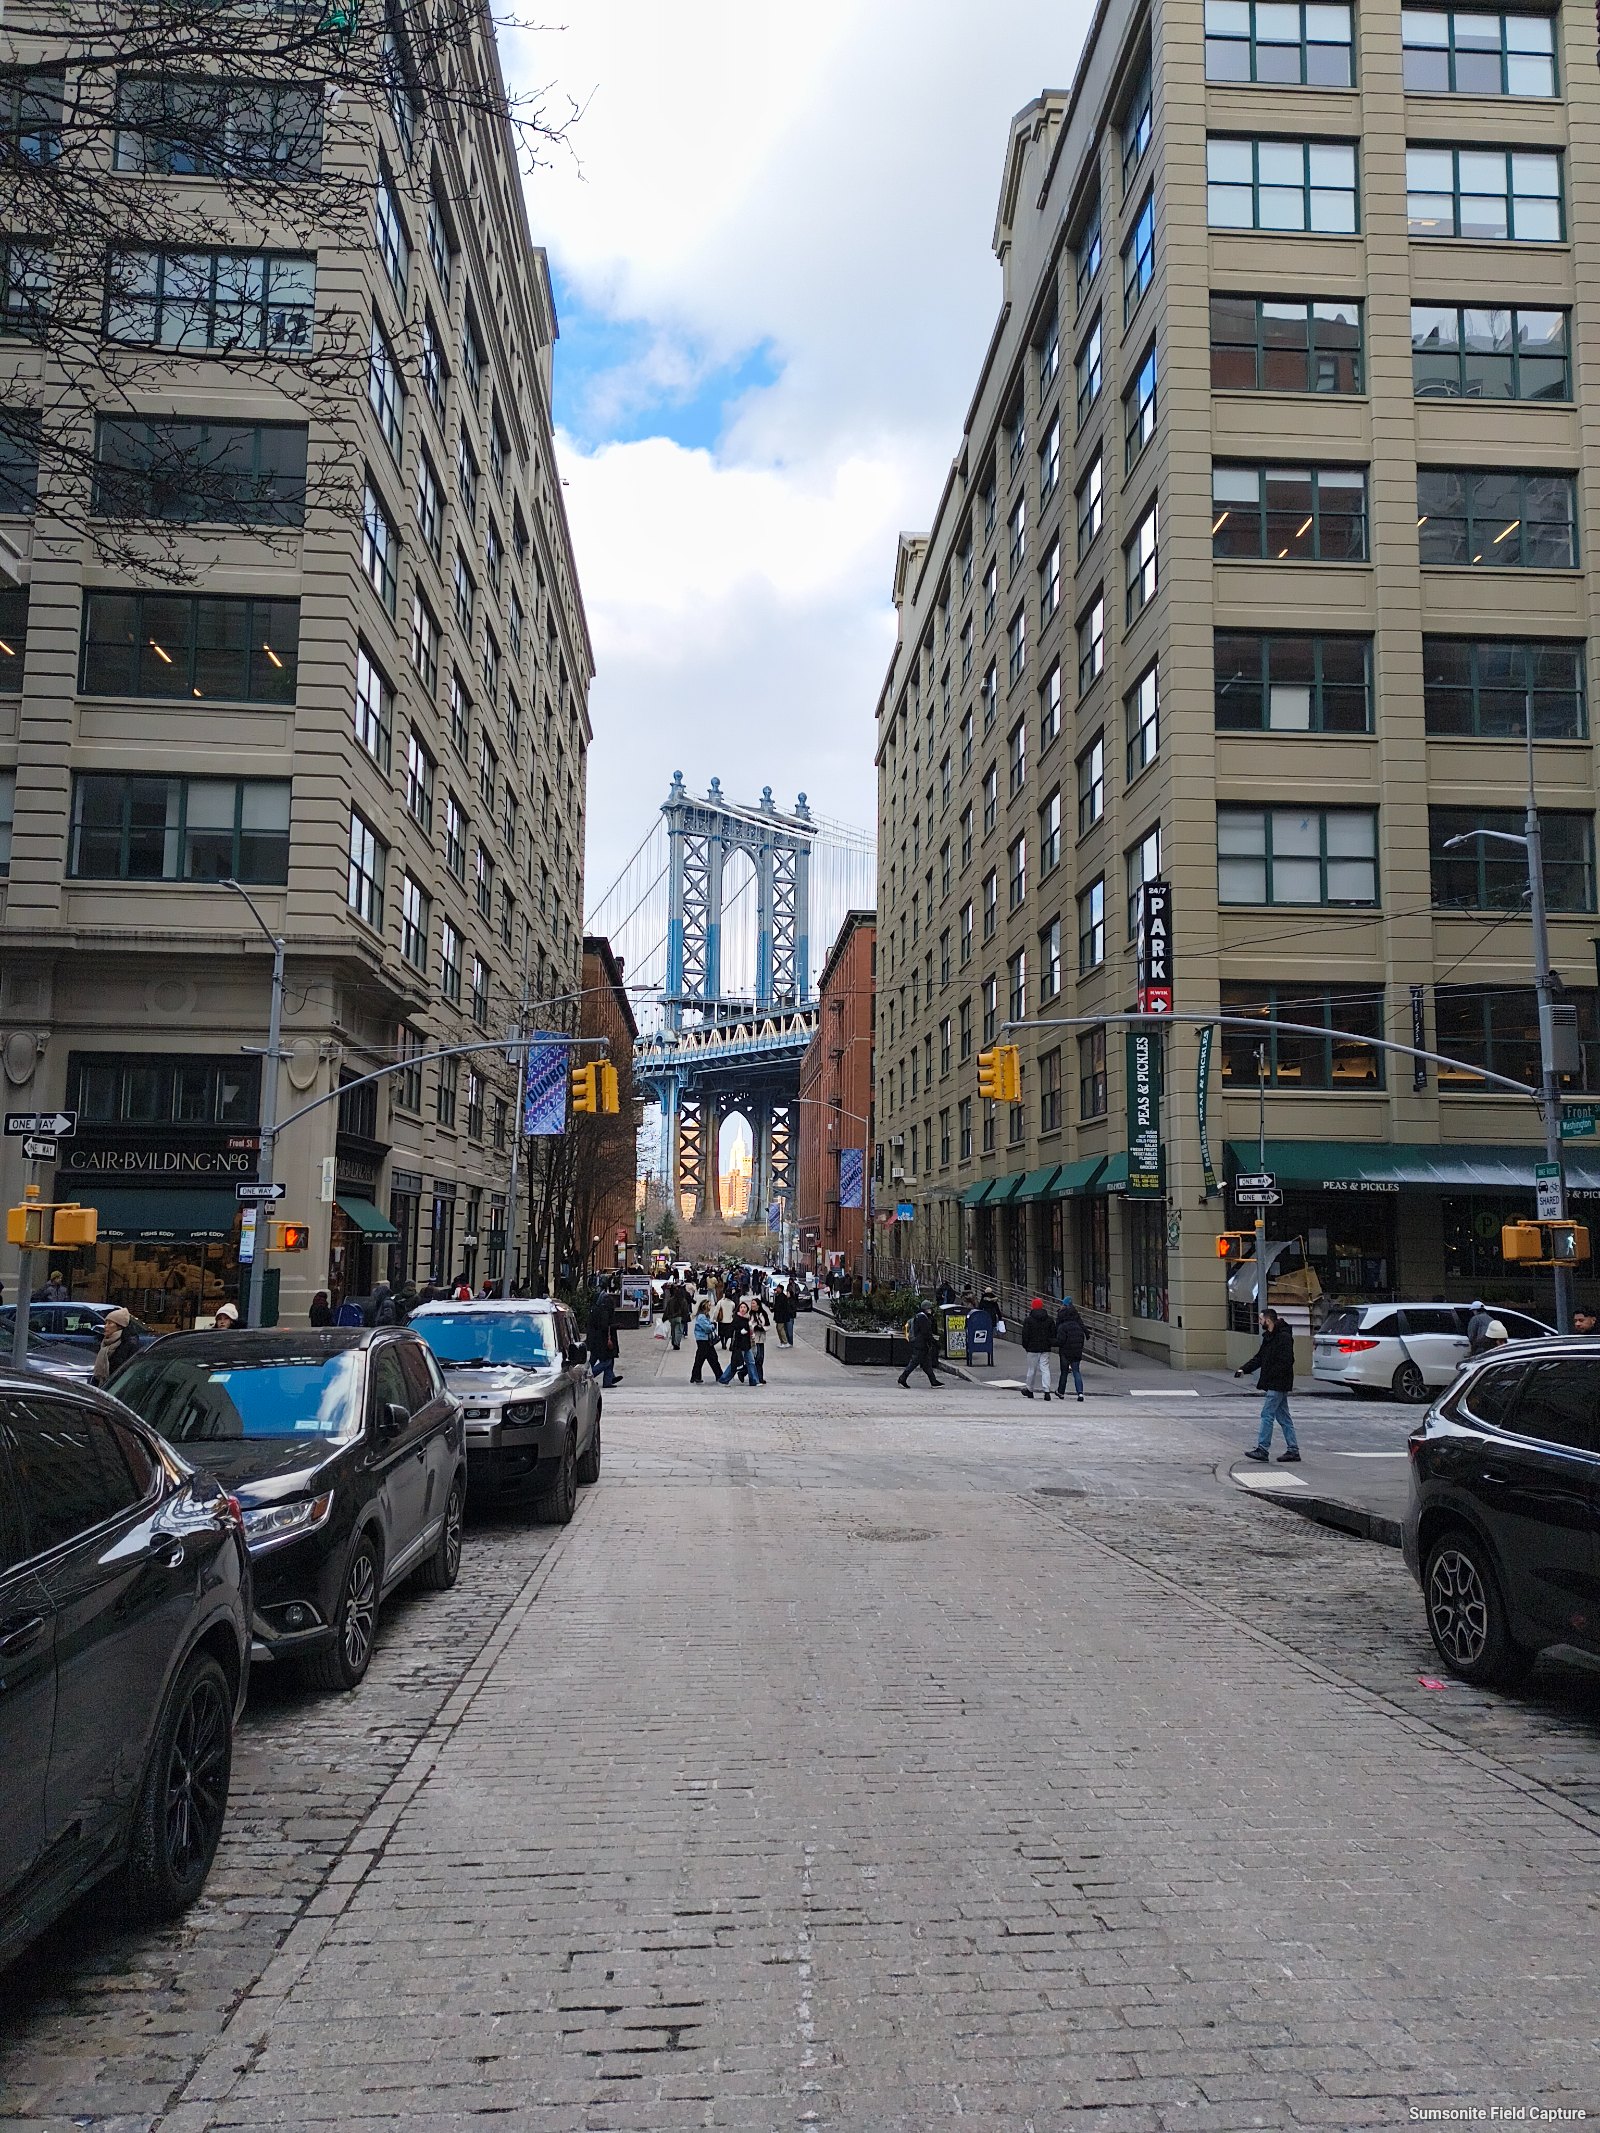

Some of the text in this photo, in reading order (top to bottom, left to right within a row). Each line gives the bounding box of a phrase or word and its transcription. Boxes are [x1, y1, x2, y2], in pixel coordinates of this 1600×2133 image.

[1150, 897, 1166, 978] PARK
[526, 1063, 567, 1104] DUMBO
[1136, 1036, 1150, 1126] PEAS & PICKLES
[1567, 1104, 1600, 1119] Front S
[12, 1119, 32, 1129] ONE
[1562, 1120, 1592, 1131] Washington
[229, 1138, 253, 1148] Front St
[27, 1143, 53, 1155] ONE WAY
[840, 1166, 862, 1191] DUMBO
[242, 1187, 256, 1195] ONE
[1322, 1181, 1400, 1192] PEAS & PICKLES
[1572, 1189, 1581, 1198] &
[1539, 1195, 1560, 1206] SHARED
[1543, 1207, 1557, 1217] LANE
